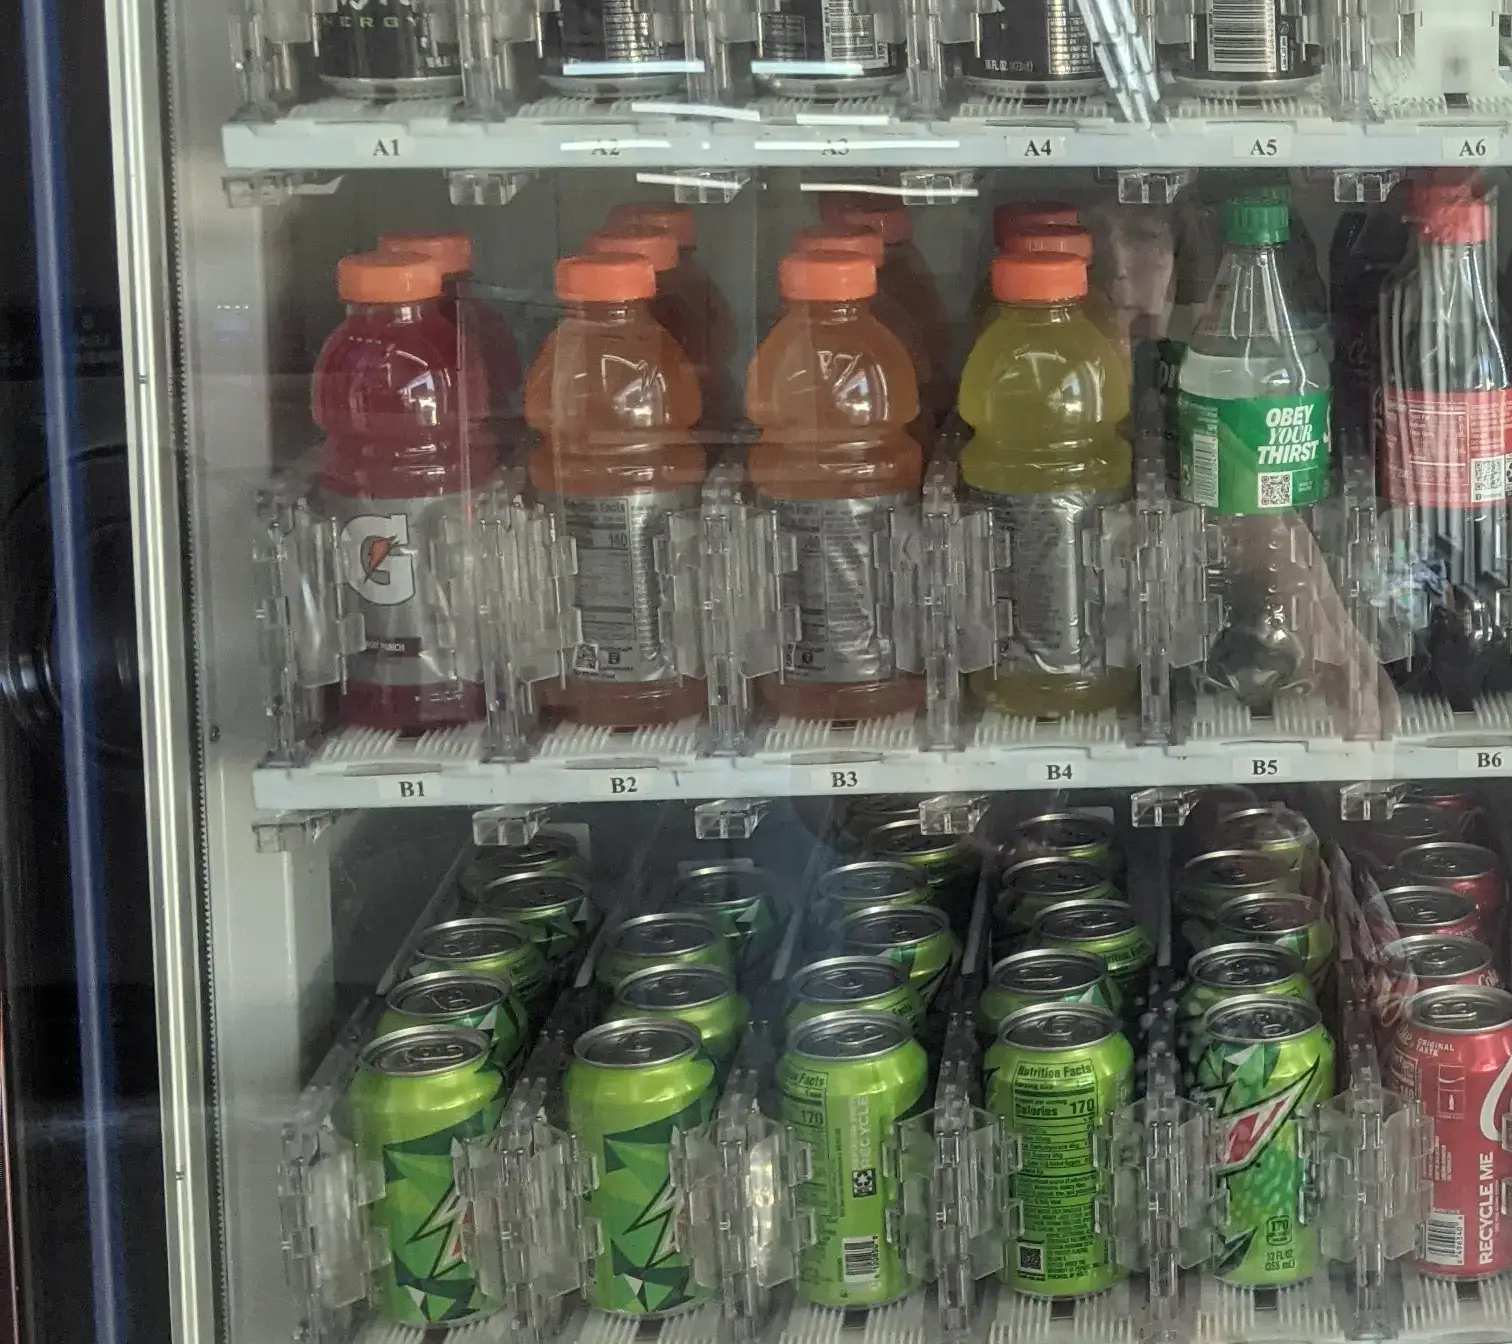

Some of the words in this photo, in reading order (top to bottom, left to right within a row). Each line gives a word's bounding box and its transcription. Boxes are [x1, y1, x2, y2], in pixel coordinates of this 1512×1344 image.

[372, 139, 401, 157] A1
[1024, 139, 1052, 157] A4
[1250, 139, 1278, 156] A5
[1459, 139, 1487, 156] A6
[1265, 404, 1315, 428] OBEY
[1268, 424, 1313, 445] YOUR
[1256, 439, 1320, 465] THIRST
[1251, 760, 1278, 776] B5
[1476, 752, 1502, 768] B6
[830, 772, 858, 789] B3
[1046, 764, 1073, 781] B4
[398, 781, 425, 798] B1
[610, 777, 638, 794] B2
[1417, 1038, 1455, 1051] ORIGINAL
[1017, 1064, 1061, 1079] Nutrition
[1063, 1064, 1092, 1078] Facts
[1015, 1103, 1058, 1116] Calories
[1069, 1098, 1095, 1114] 170
[1479, 1151, 1494, 1180] ME
[1479, 1182, 1494, 1266] RECYCLE
